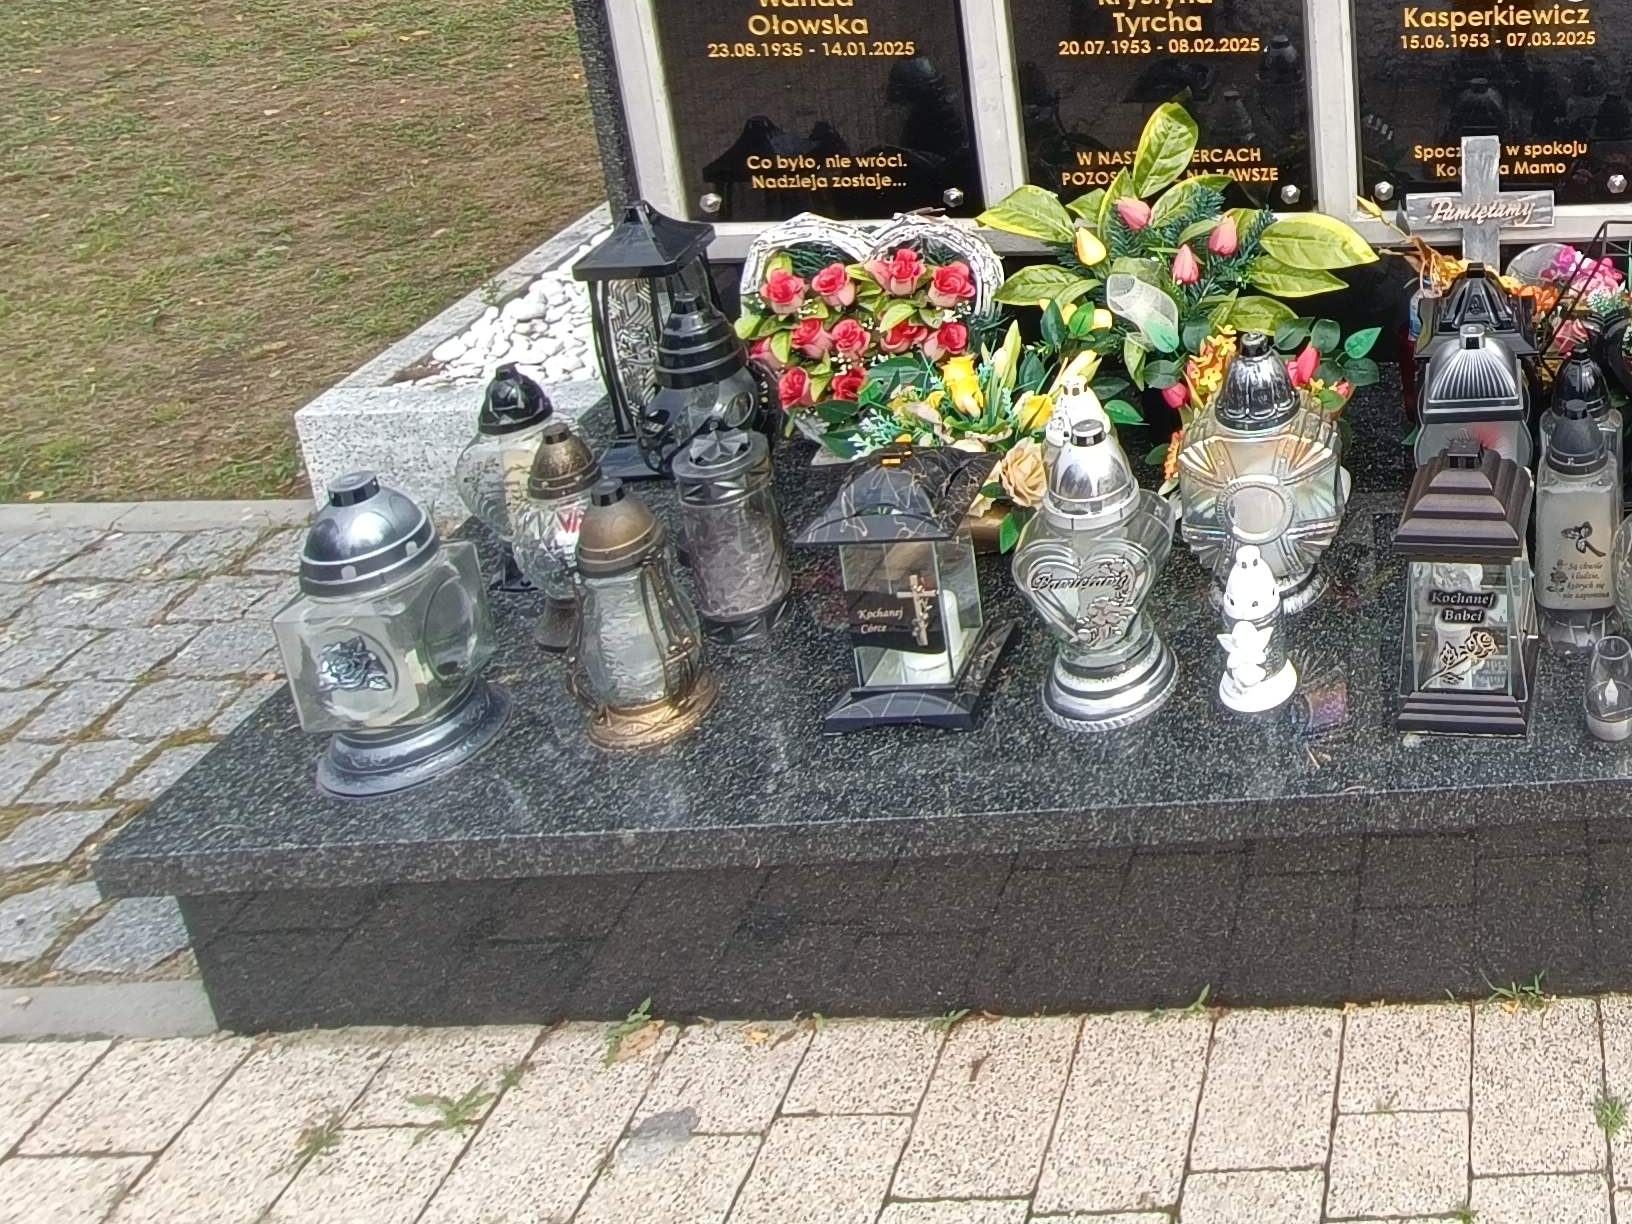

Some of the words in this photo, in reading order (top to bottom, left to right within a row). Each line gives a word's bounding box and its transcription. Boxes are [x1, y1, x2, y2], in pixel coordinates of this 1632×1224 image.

[747, 12, 870, 37] Ołowska
[1111, 9, 1204, 39] Tyrcha
[1403, 2, 1591, 33] Kasperkiewicz
[1058, 39, 1152, 56] 20.07.1953
[1168, 37, 1261, 54] 08.02.2025
[1400, 32, 1490, 49] 15.06.1953
[1506, 30, 1596, 47] 07.03.2025
[707, 42, 804, 58] 23.08.1935
[821, 41, 915, 57] 14.01.2025
[1191, 147, 1262, 164] ERCACH
[1413, 143, 1500, 162] Spocz
[1523, 139, 1588, 160] spokoju
[746, 155, 773, 170] Co
[776, 154, 821, 172] było,
[825, 153, 852, 168] nie
[855, 151, 908, 168] wróci.
[1513, 161, 1567, 176] Mamo
[751, 173, 829, 191] Nadzieja
[831, 172, 906, 190] zostaje...
[1430, 591, 1495, 609] Kochanej
[1444, 609, 1483, 622] Babci
